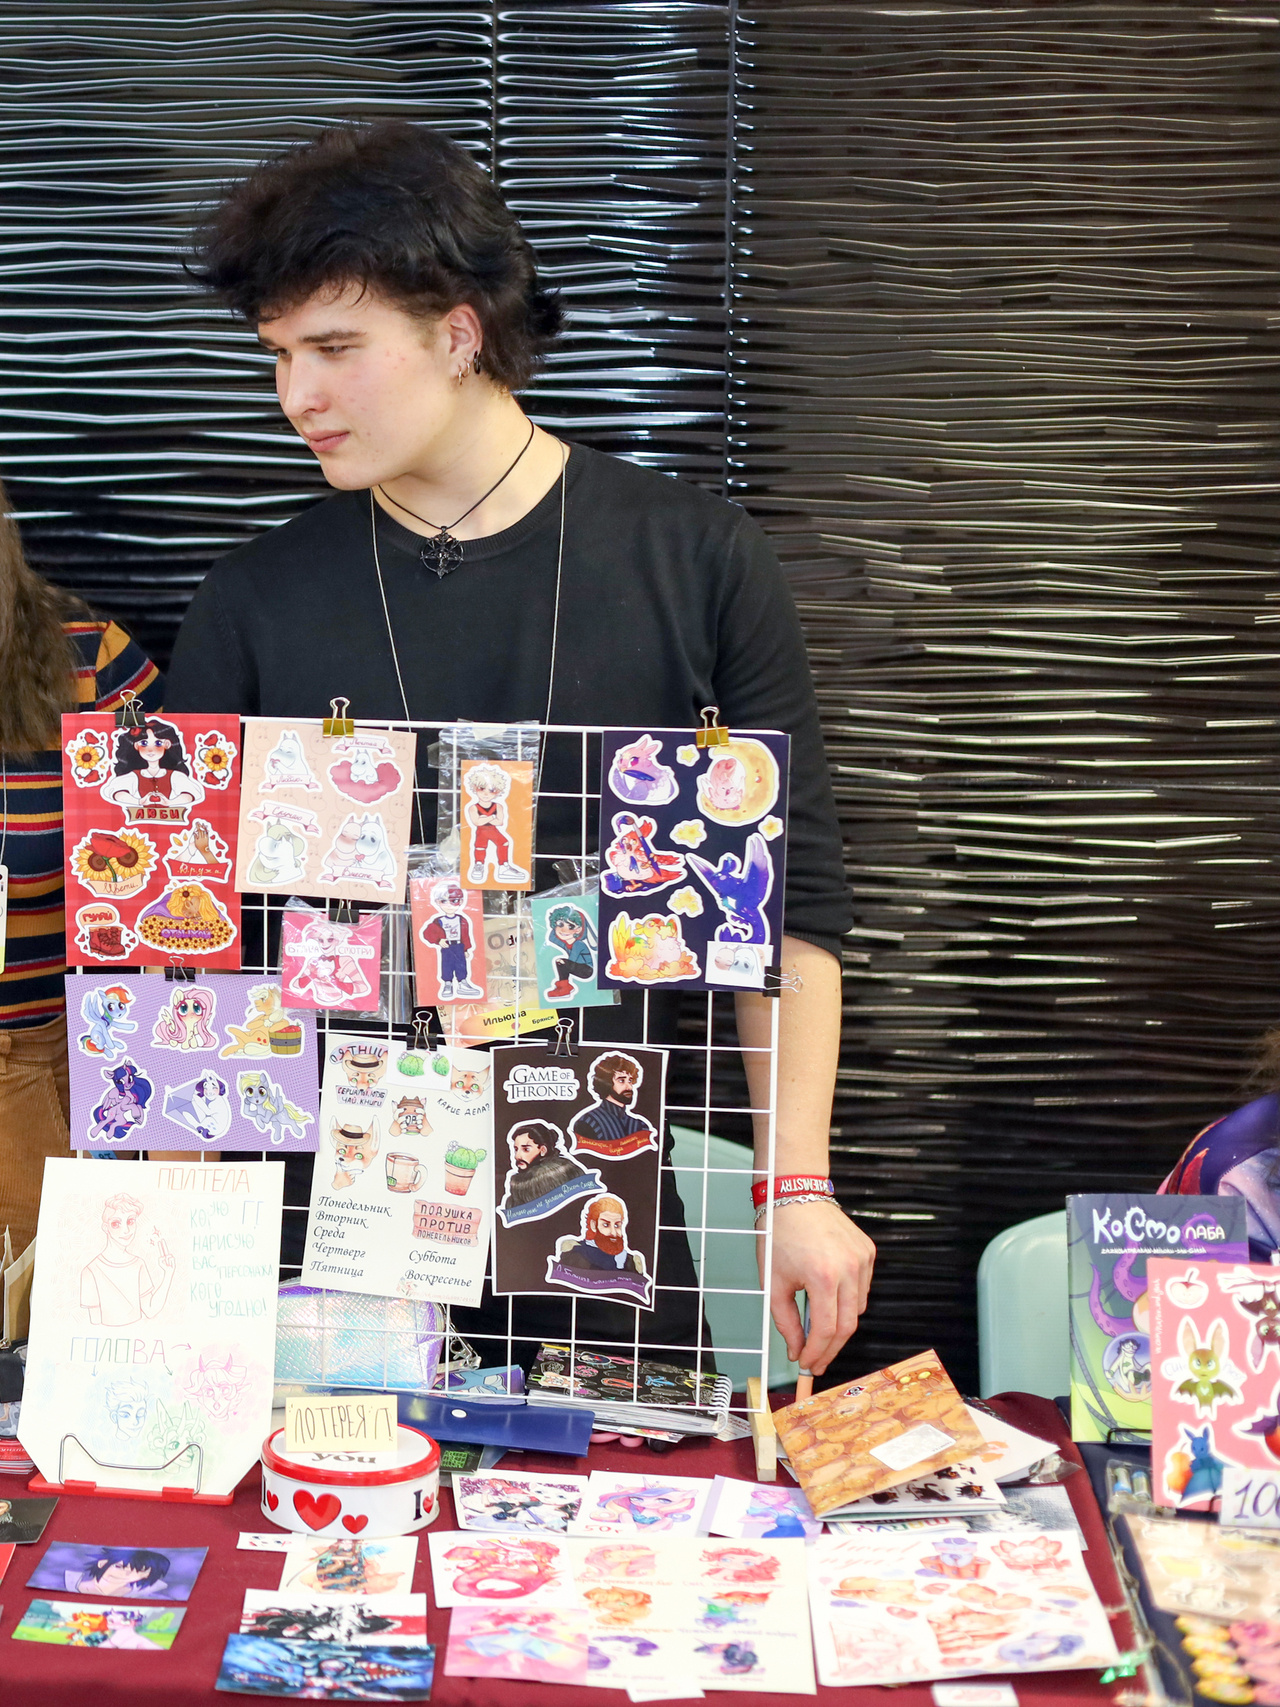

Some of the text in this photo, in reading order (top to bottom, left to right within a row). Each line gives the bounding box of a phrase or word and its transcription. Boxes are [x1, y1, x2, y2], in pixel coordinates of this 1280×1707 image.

[135, 808, 181, 820] ЛЮБИ
[83, 911, 113, 923] ГУЛЯЙ
[513, 1068, 571, 1084] GAME OF
[510, 1084, 574, 1099] THRONES
[437, 1098, 491, 1116] КАКИЕ ДЕЛА?
[157, 1167, 250, 1193] ПОЛТЕЛА
[317, 1196, 393, 1217] Понедельник
[420, 1204, 473, 1221] ПОДУШКА
[315, 1211, 369, 1229] Вторник
[419, 1217, 471, 1234] ПРОТИВ
[313, 1226, 345, 1240] Среда
[193, 1233, 254, 1251] НАРИСУЮ
[408, 1249, 457, 1265] Суббота
[309, 1261, 364, 1278] Пятница
[405, 1270, 472, 1287] Воскресенье
[190, 1282, 222, 1302] КОГО
[209, 1300, 267, 1319] УГОДНО!
[70, 1337, 166, 1364] ГОЛОВА
[294, 1404, 367, 1444] ЛОТЕРЕЯ
[312, 1451, 376, 1464] you
[1235, 1479, 1280, 1519] 10
